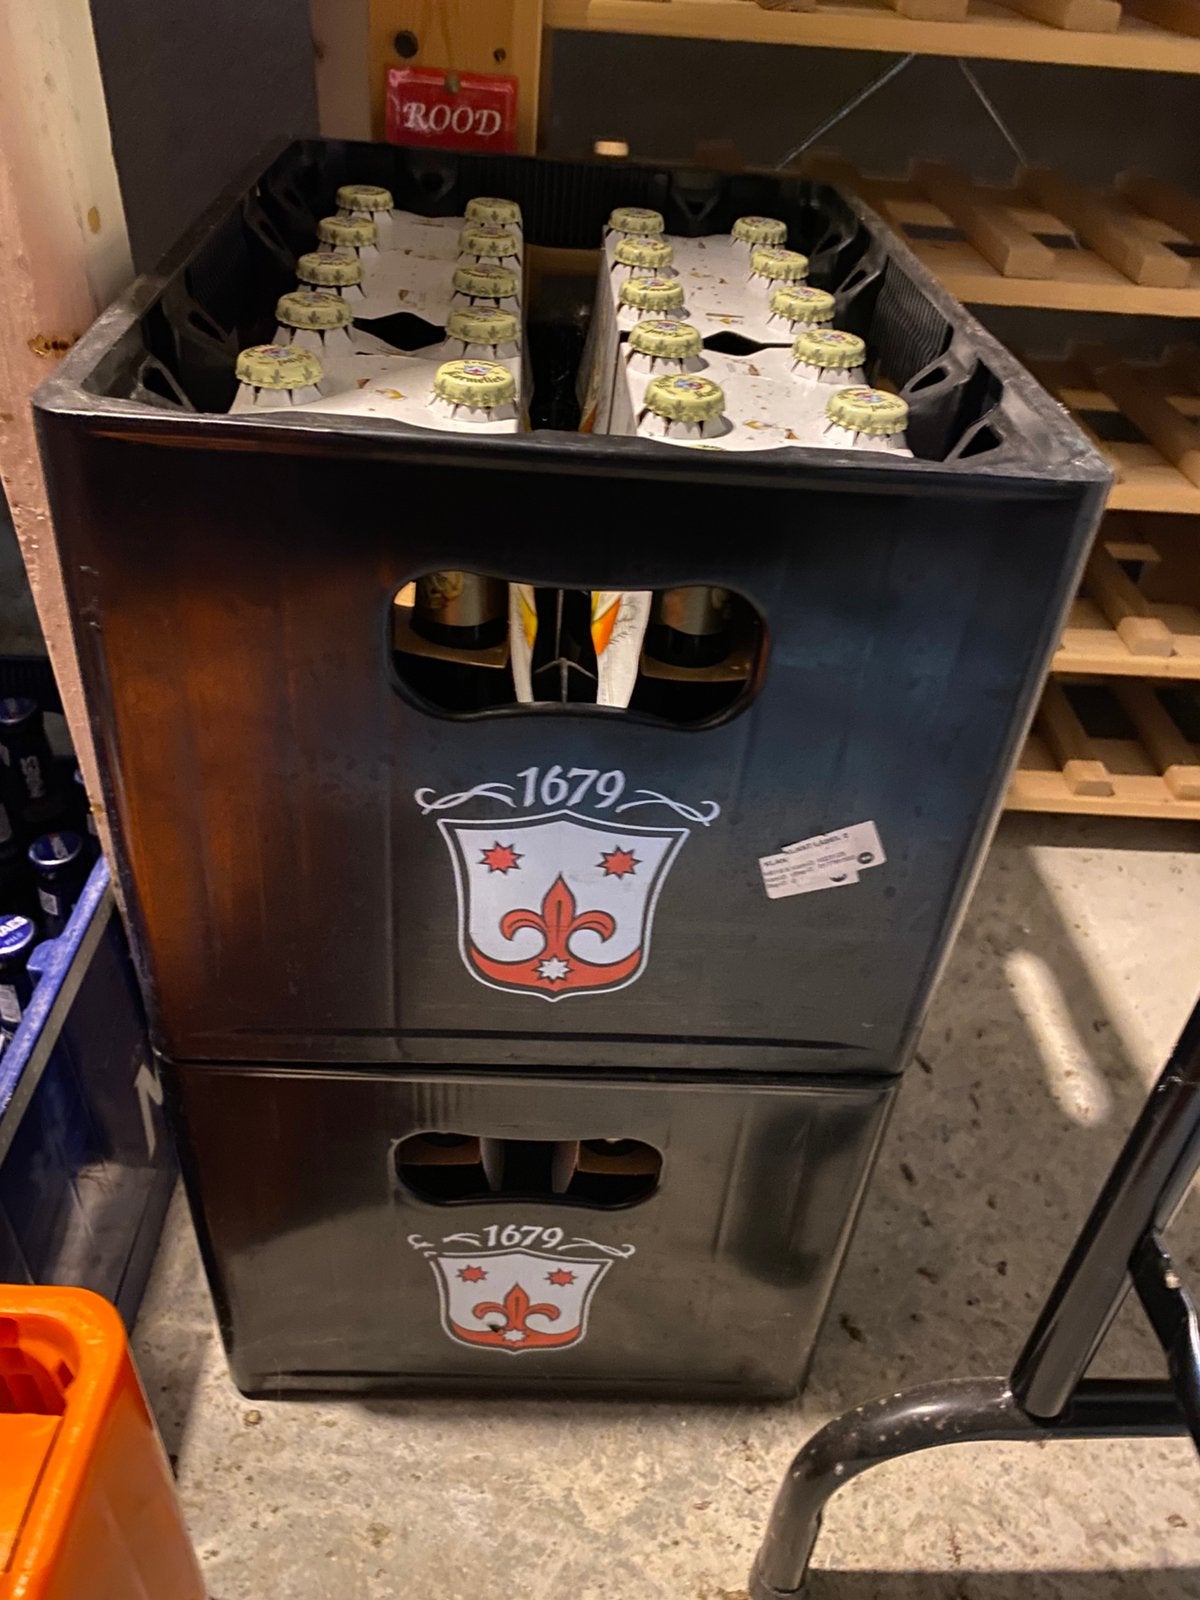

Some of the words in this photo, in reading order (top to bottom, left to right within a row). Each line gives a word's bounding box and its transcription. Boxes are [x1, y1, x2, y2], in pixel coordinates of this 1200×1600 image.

[402, 101, 502, 137] ROOD
[516, 765, 626, 809] 1679
[482, 1224, 564, 1248] 1679
